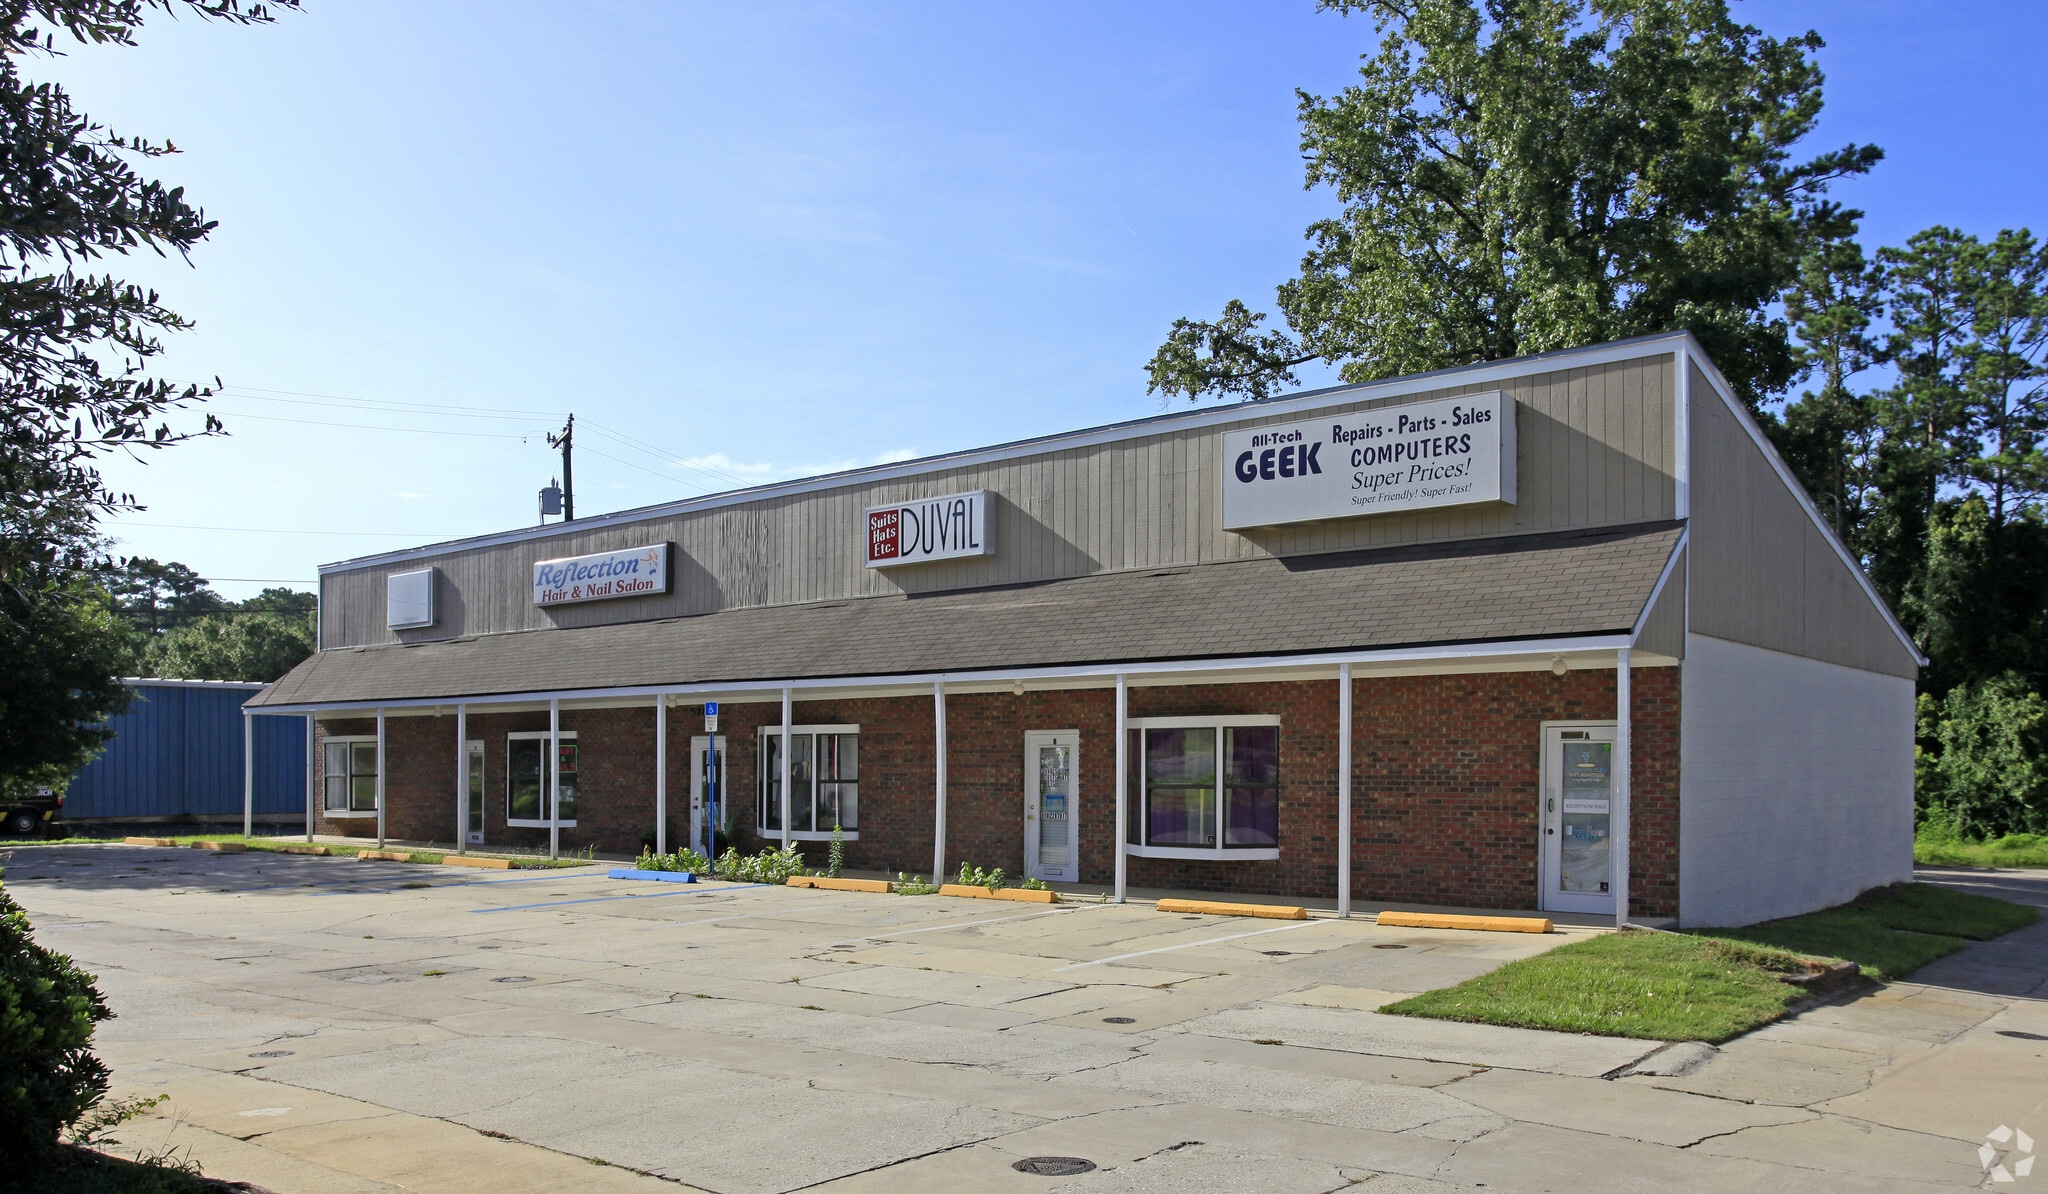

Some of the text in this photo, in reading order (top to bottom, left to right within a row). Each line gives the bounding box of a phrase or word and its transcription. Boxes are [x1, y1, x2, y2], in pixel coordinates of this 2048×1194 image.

[1251, 429, 1302, 448] All-Tech
[1332, 424, 1383, 445] Repairs
[1398, 414, 1436, 435] Parts
[1452, 406, 1491, 427] Sales
[1234, 441, 1323, 484] GEEK
[1350, 433, 1471, 468] COMPUTERS
[1351, 457, 1472, 492] Super Prices!
[1351, 482, 1472, 506] Super Friendly! Super Fast!
[870, 512, 897, 531] Suits
[901, 498, 979, 557] DUVAL
[872, 527, 896, 544] Hats
[874, 542, 895, 557] Etc.
[535, 556, 639, 589] Reflection
[542, 577, 653, 603] Hair & Nail Salon
[1584, 732, 1590, 740] A
